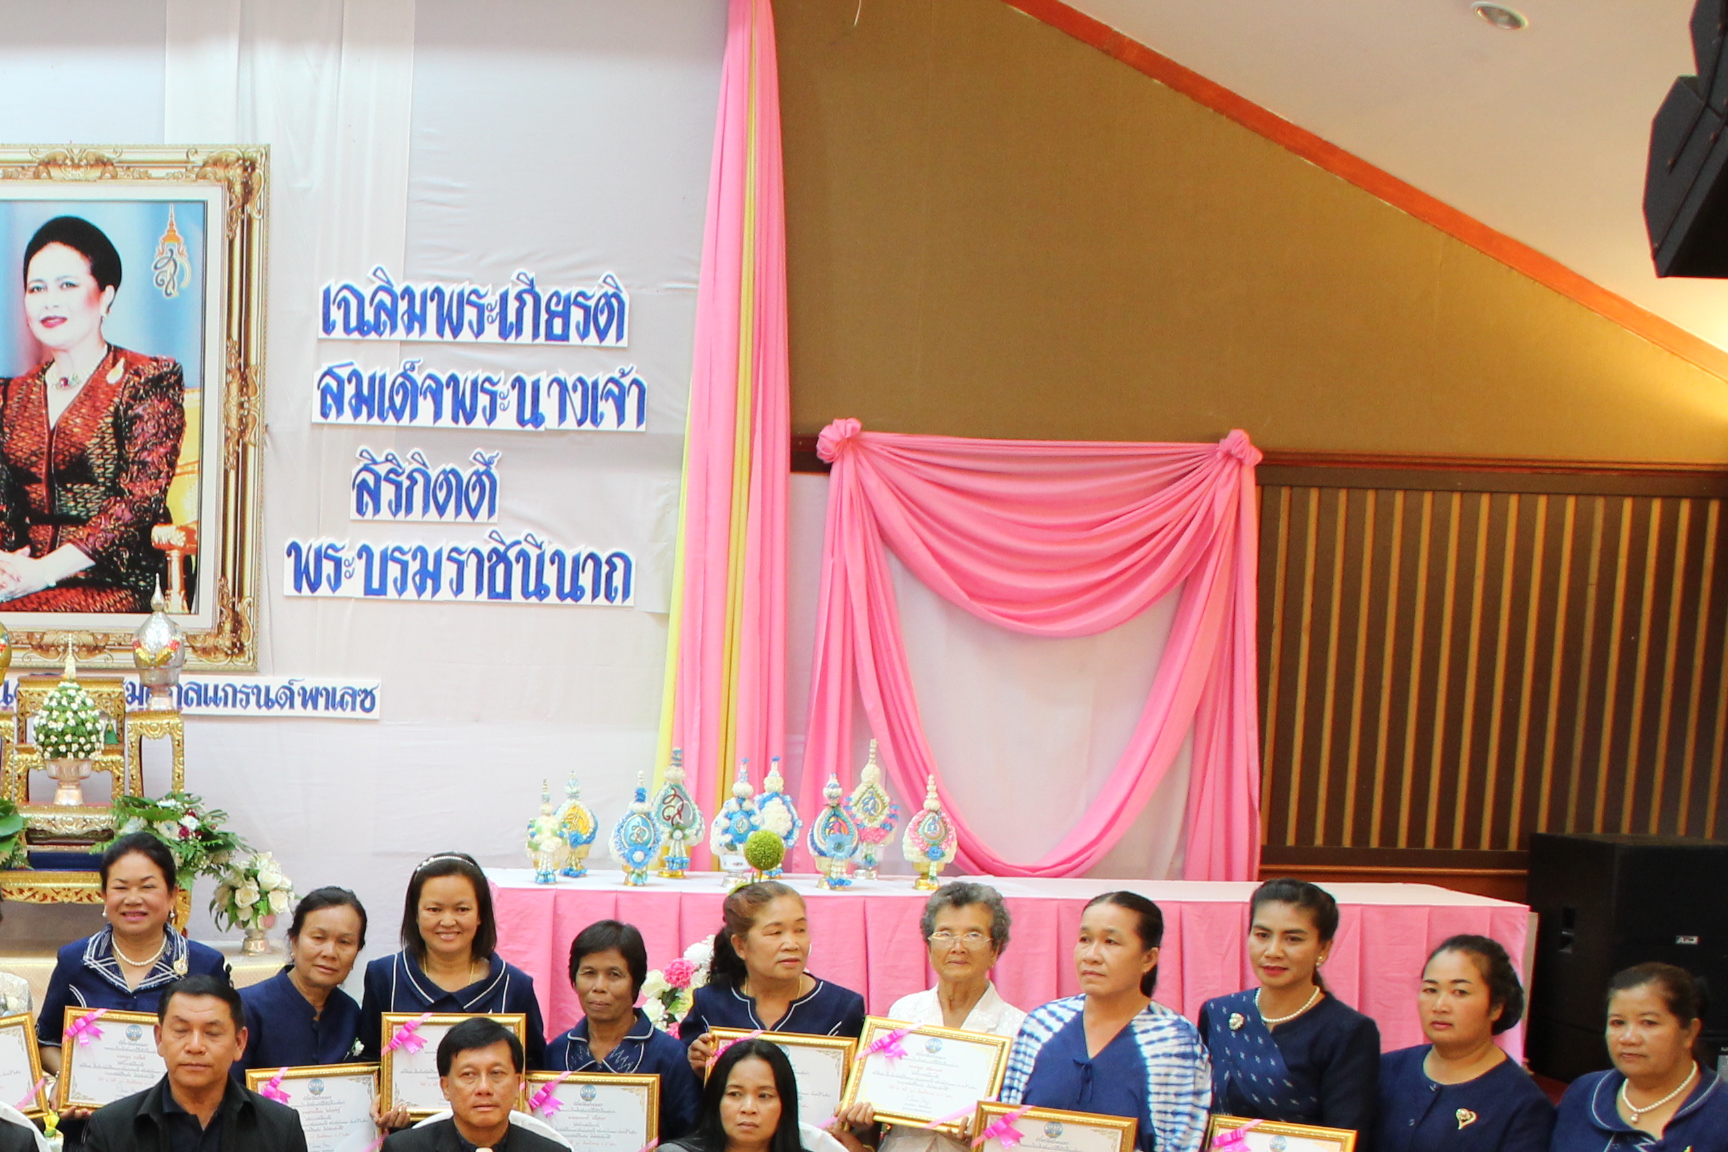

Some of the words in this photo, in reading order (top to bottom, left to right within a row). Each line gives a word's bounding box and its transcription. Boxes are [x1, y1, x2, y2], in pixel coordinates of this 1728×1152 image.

[322, 265, 627, 343] เฉลิมพระเกียรติ
[318, 358, 648, 429] สมเด็จพระนางเจ้า
[352, 448, 501, 520] สิริกิตติ์
